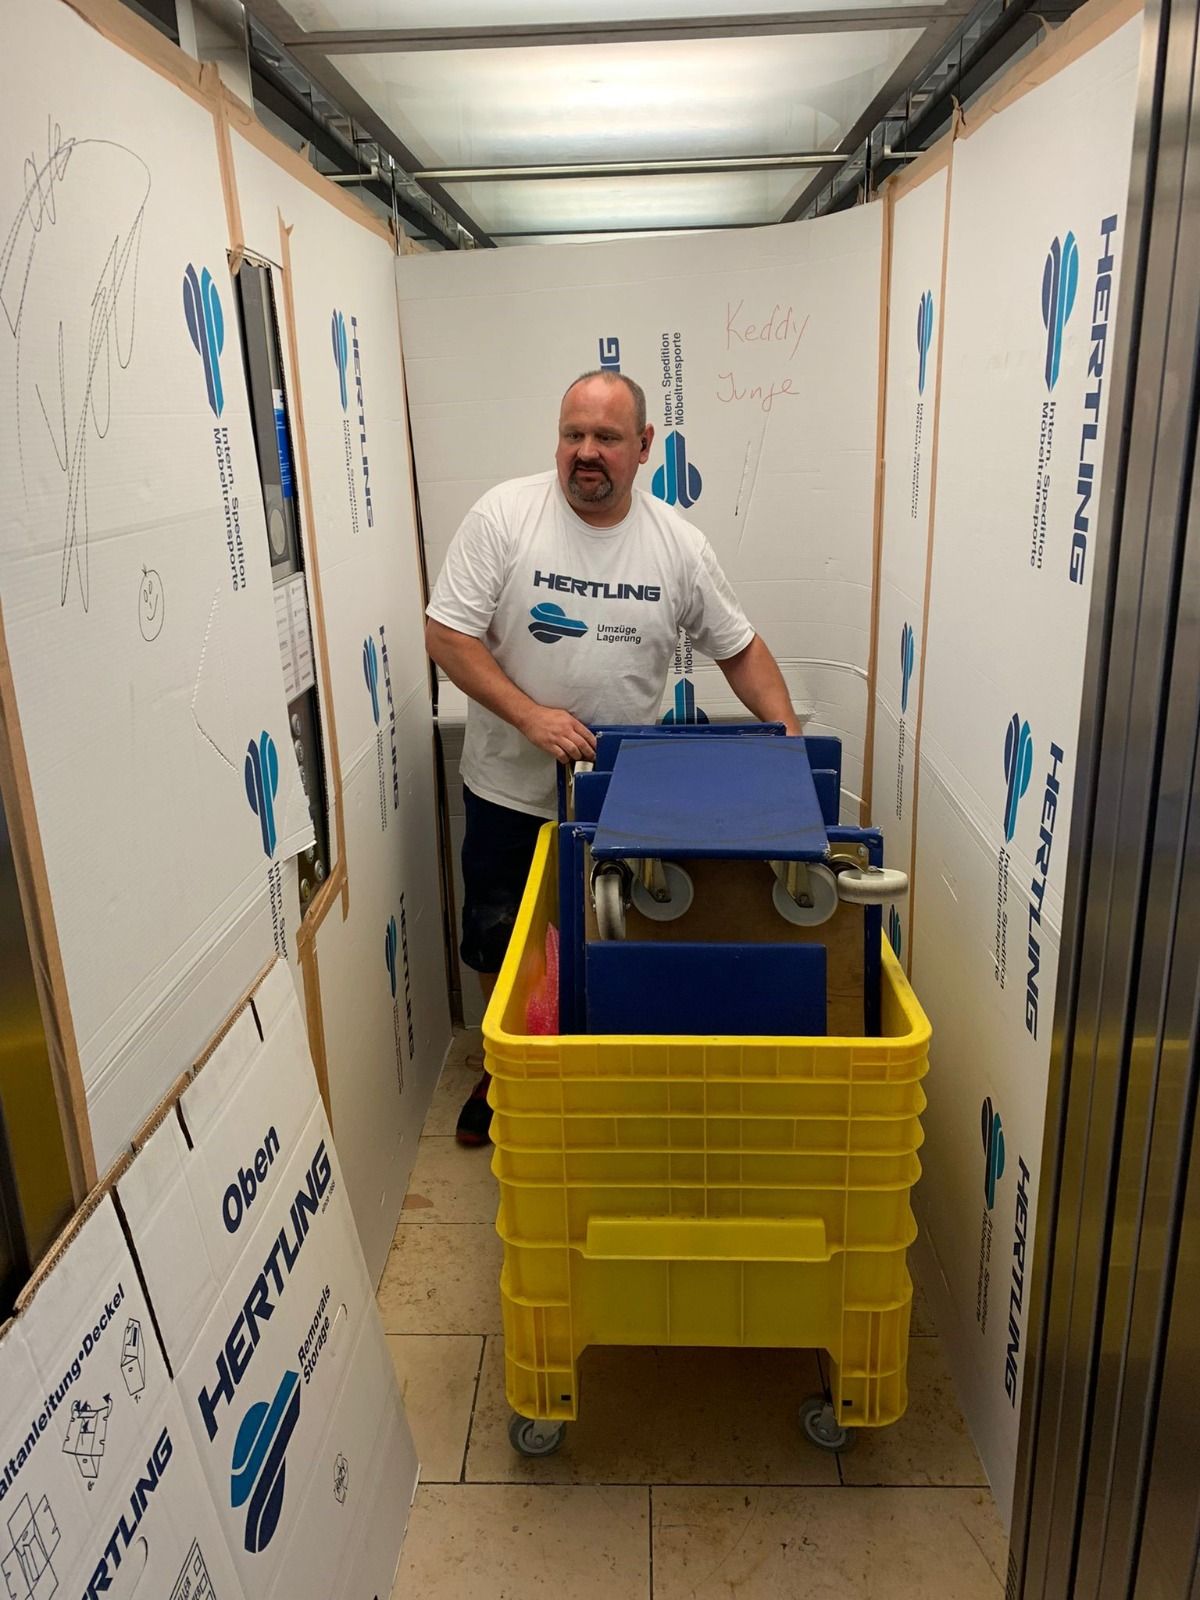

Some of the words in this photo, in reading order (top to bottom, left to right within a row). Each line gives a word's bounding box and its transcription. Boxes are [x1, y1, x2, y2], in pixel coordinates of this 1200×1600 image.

[660, 332, 672, 388] Spedition
[672, 331, 684, 426] Möbeltransporte
[1069, 214, 1118, 585] HERTLING
[351, 316, 374, 528] HERTLING
[664, 390, 673, 427] Intern.
[1045, 401, 1057, 468] Intern.
[213, 427, 239, 592] Möbeltransporte
[222, 427, 235, 491] Intern.
[231, 497, 247, 589] Spedition
[1030, 401, 1049, 567] Möbeltransporte
[1036, 475, 1051, 569] Spedition
[533, 570, 661, 602] HERTLING
[596, 623, 637, 636] Umzüge
[596, 632, 642, 645] Lagerung
[684, 635, 693, 674] Möbeltr
[379, 624, 400, 811] HERTLING
[267, 867, 280, 955] Möbeltran
[273, 860, 283, 915] Intern.
[1025, 741, 1064, 1042] HERTLING
[1000, 911, 1008, 990] Spedition
[222, 1125, 280, 1234] Oben
[197, 1138, 332, 1443] HERTLING
[298, 1284, 331, 1368] Removals
[1004, 1155, 1031, 1409] HERTLING
[303, 1315, 331, 1385] Storage
